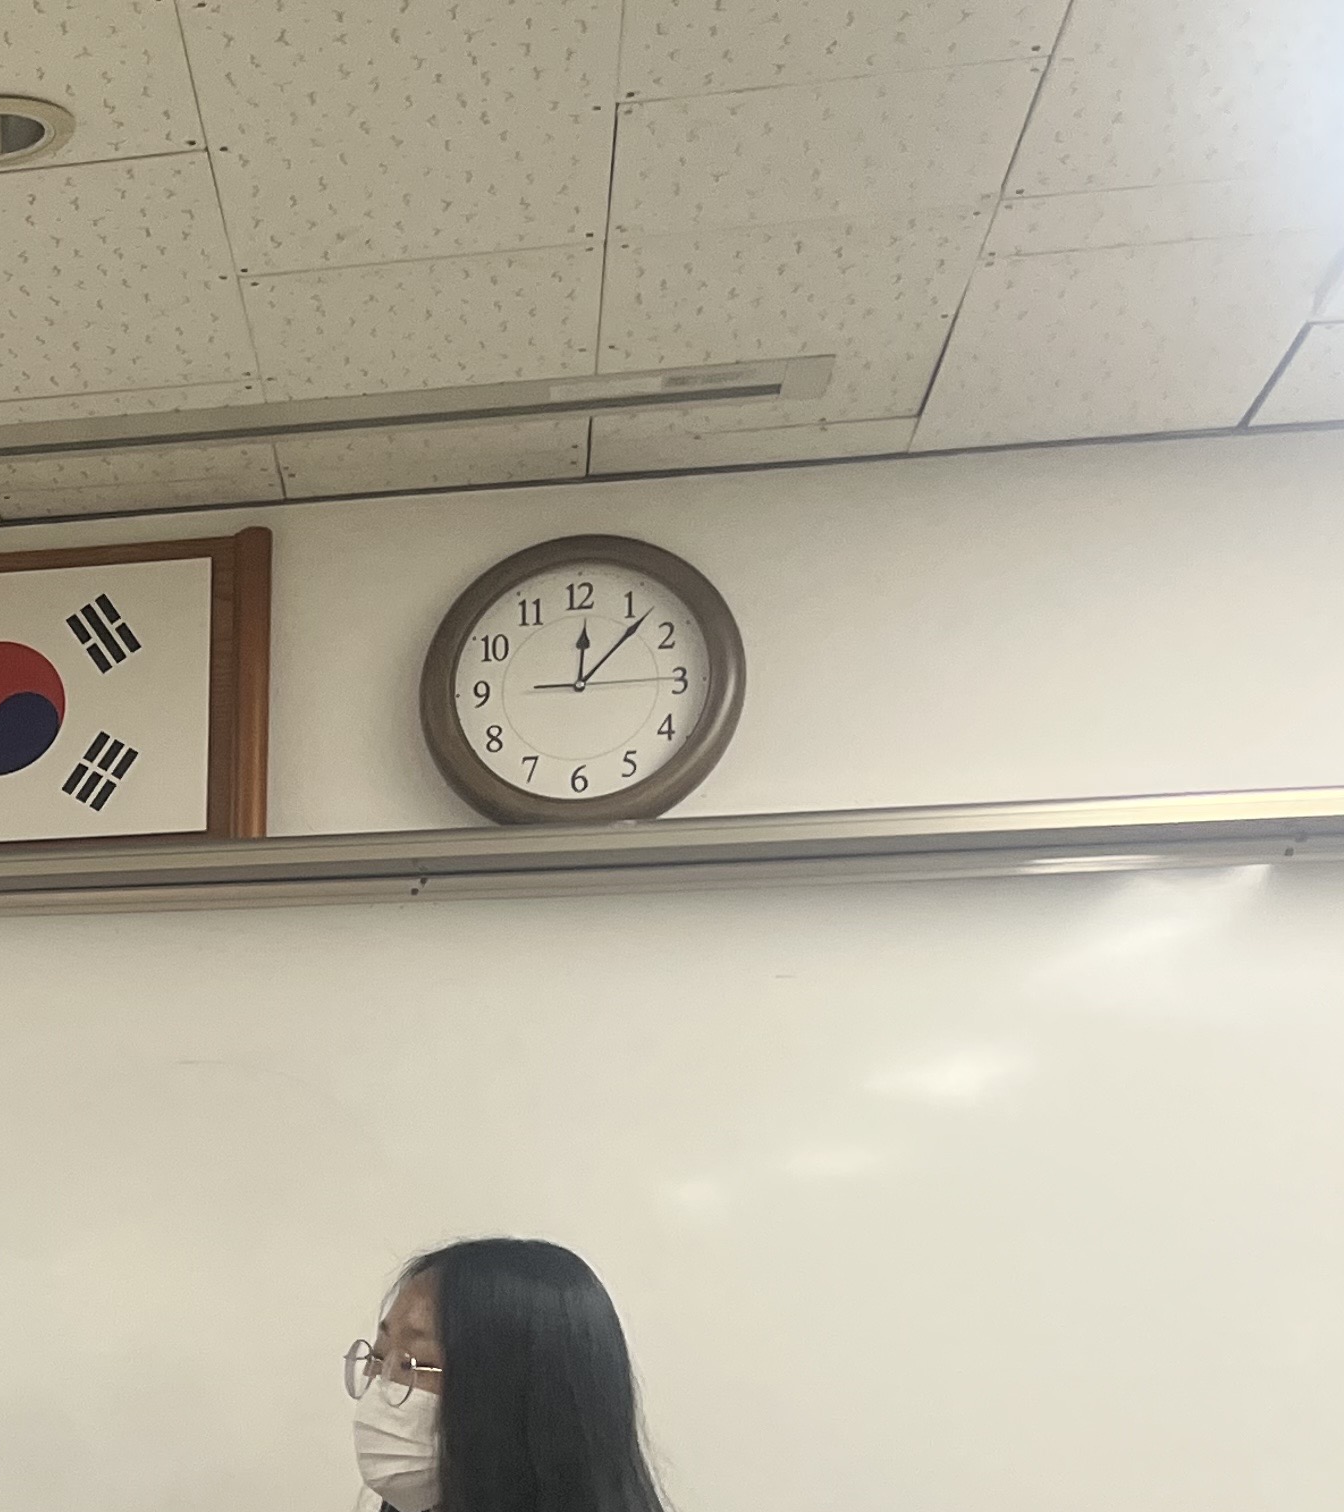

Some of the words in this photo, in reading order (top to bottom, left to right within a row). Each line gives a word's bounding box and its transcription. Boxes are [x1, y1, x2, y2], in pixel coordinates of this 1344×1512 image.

[566, 582, 594, 610] 12
[624, 591, 636, 618] 1
[518, 598, 544, 626] 11
[481, 634, 509, 662] 10
[658, 622, 676, 649] 2
[671, 667, 688, 694] 3
[473, 681, 490, 708] 9
[485, 725, 503, 752] 8
[657, 714, 675, 740] 4
[521, 756, 539, 783] 7
[621, 750, 637, 777] 5
[571, 765, 588, 792] 6
